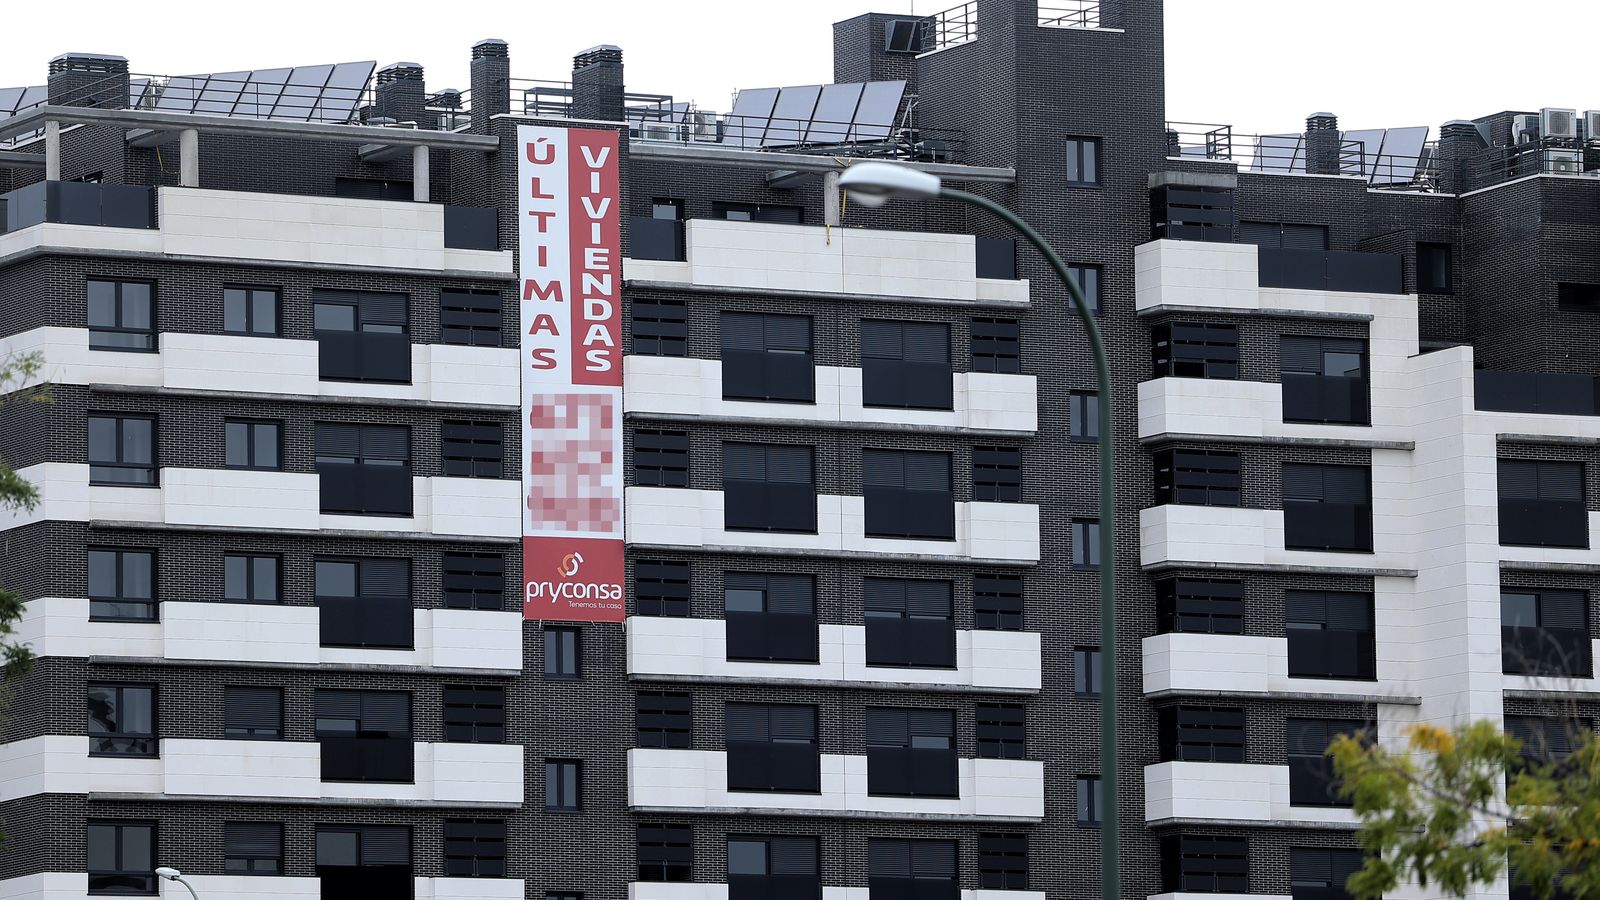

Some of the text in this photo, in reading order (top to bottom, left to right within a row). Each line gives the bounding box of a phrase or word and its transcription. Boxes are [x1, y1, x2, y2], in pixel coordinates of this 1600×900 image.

[522, 137, 564, 370] ÚLTIMAS
[579, 145, 615, 372] VIVIENDAS
[526, 581, 622, 603] pryconsa
[569, 600, 598, 609] Tenemos
